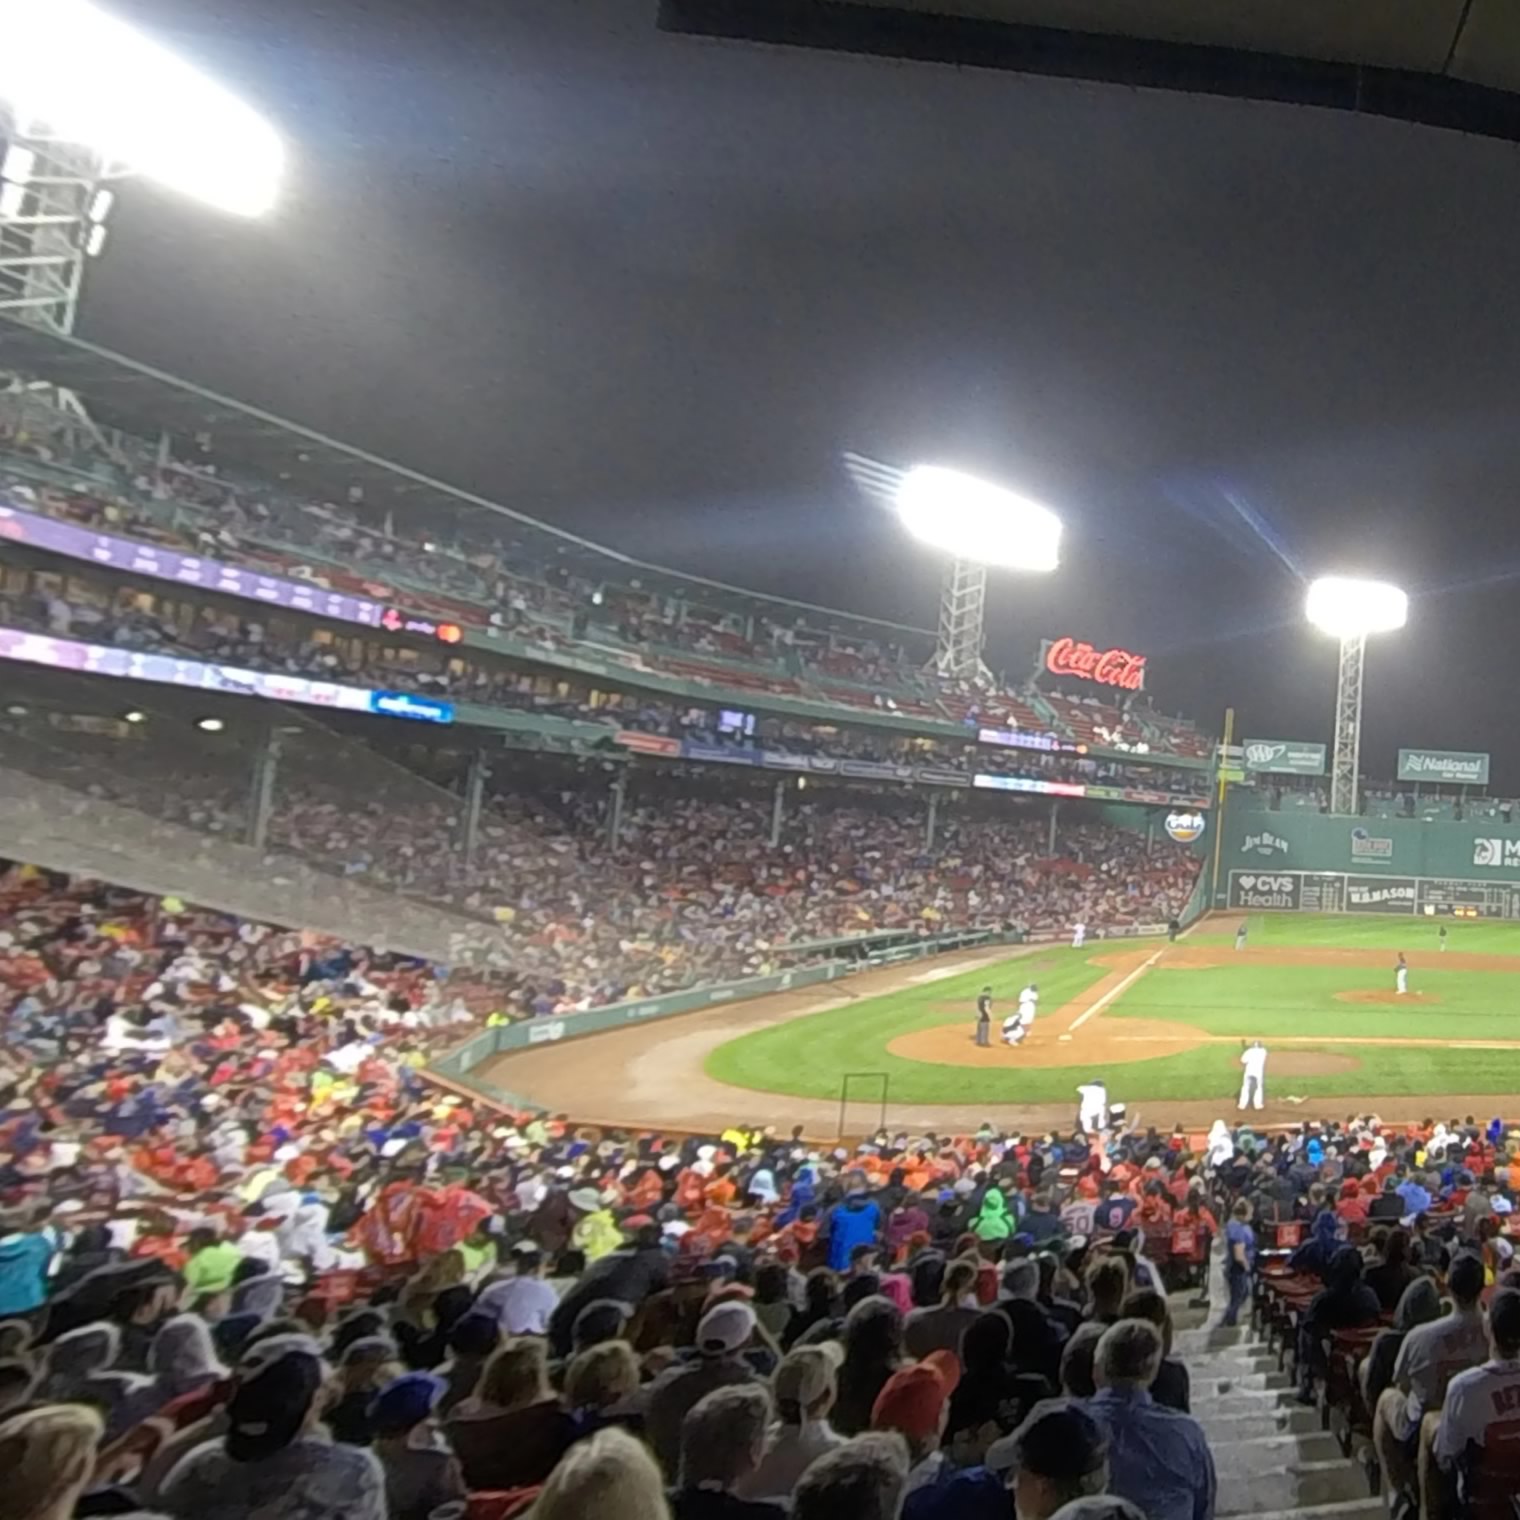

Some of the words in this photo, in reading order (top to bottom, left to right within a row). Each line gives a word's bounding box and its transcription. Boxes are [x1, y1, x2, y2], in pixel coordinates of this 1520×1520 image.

[1424, 757, 1481, 772] National
[1257, 876, 1294, 893] CVS
[1239, 891, 1293, 908] Health
